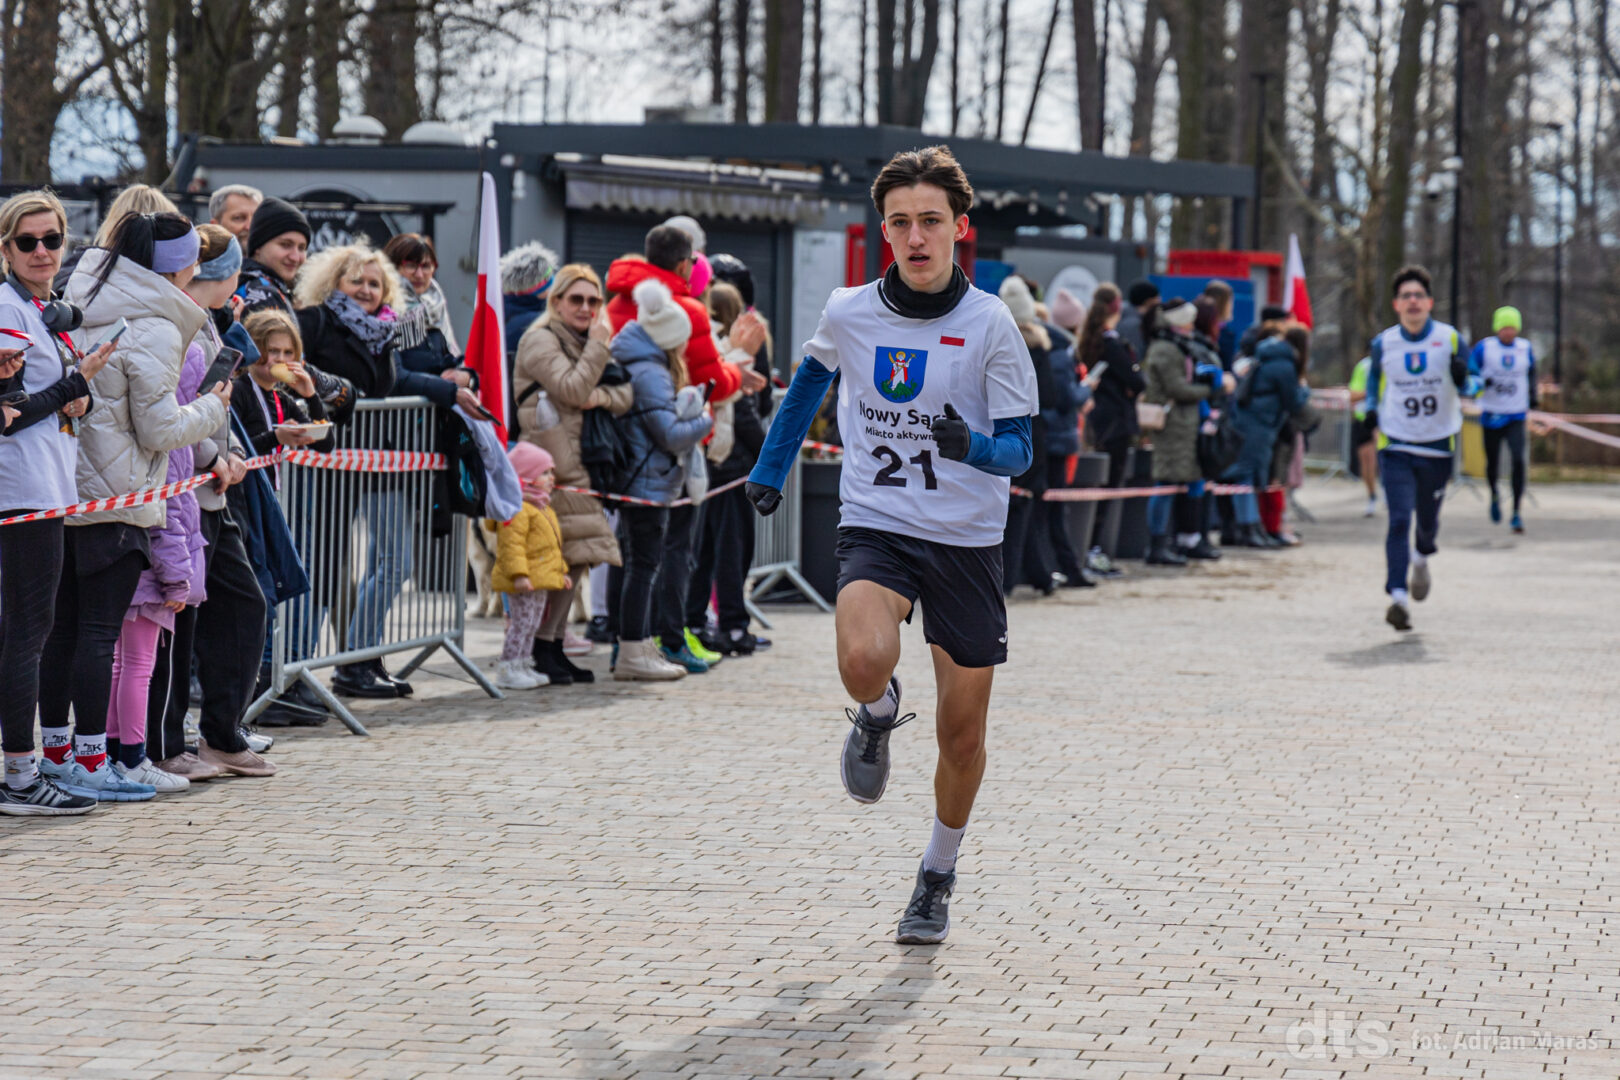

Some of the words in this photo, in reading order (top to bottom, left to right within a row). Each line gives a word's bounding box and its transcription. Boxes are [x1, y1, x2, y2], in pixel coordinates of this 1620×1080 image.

[859, 400, 901, 427] Nowy
[1404, 395, 1438, 417] 99
[865, 426, 894, 439] Miasto
[871, 445, 938, 490] 21
